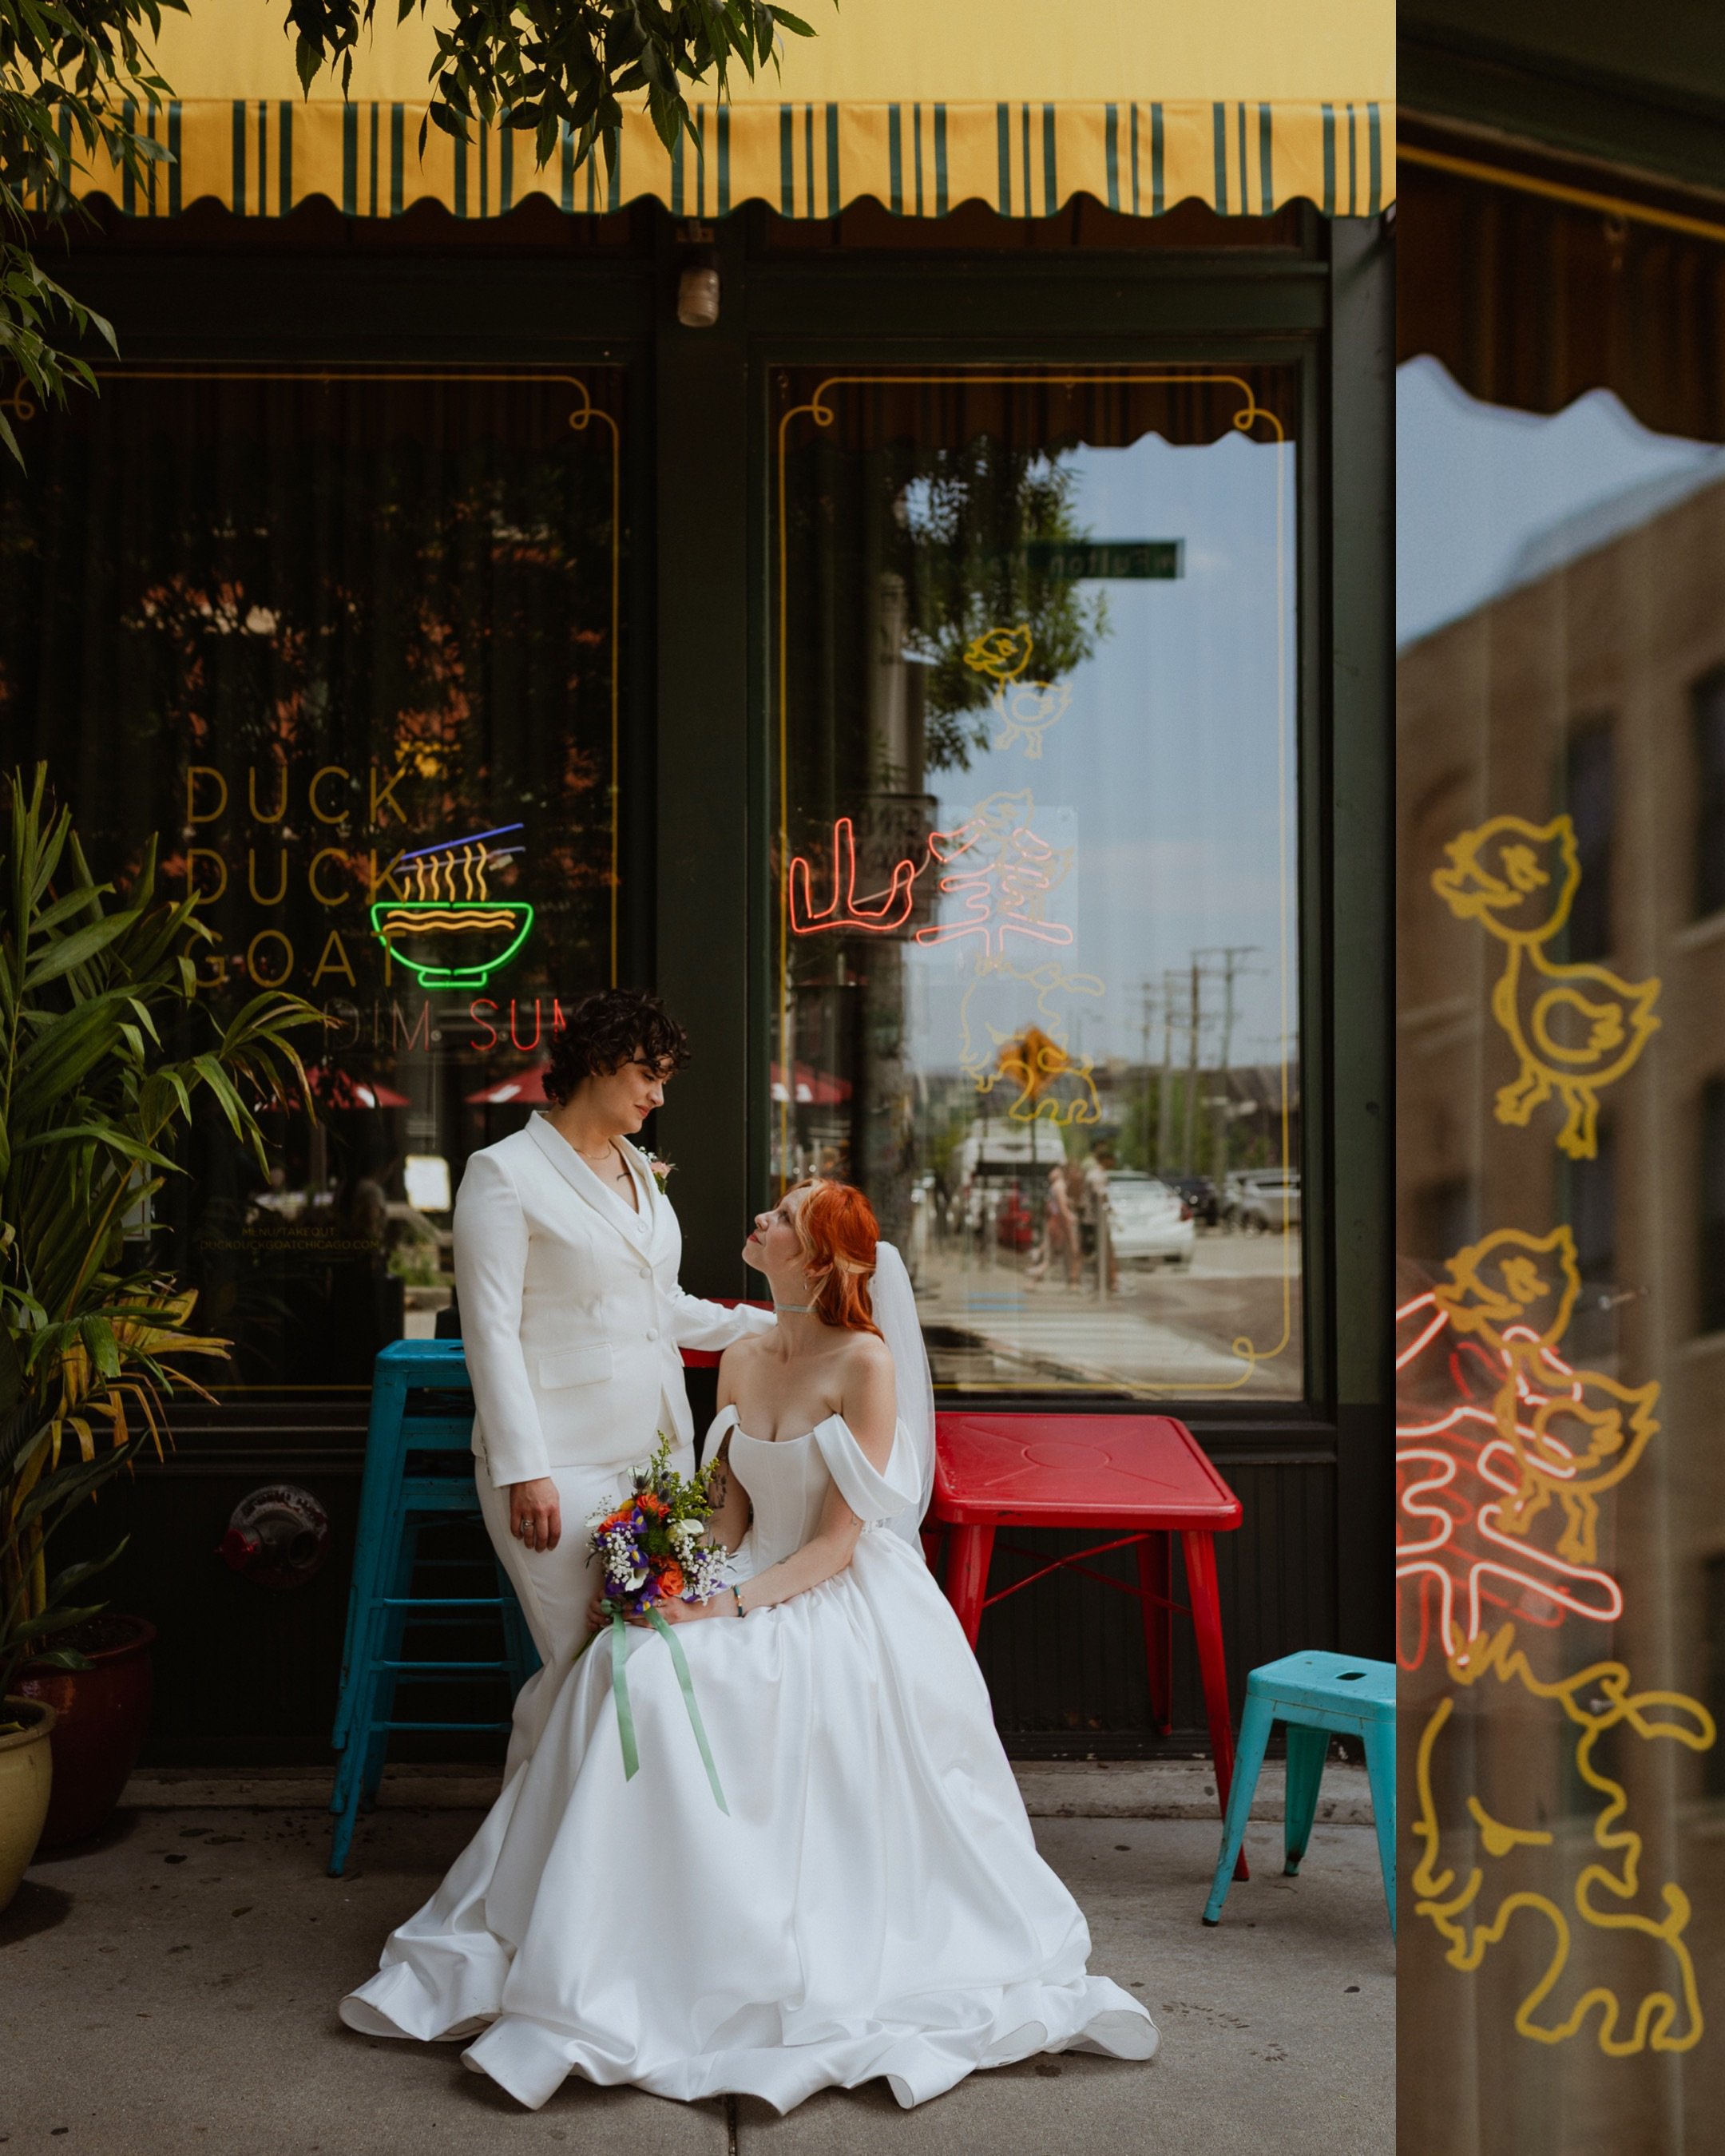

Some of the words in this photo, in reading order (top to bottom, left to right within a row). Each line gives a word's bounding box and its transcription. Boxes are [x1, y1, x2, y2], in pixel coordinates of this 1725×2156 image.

[187, 766, 407, 824] DUCK
[187, 847, 407, 906] DUCK
[183, 929, 407, 989] GOAT
[322, 998, 430, 1052] DIM
